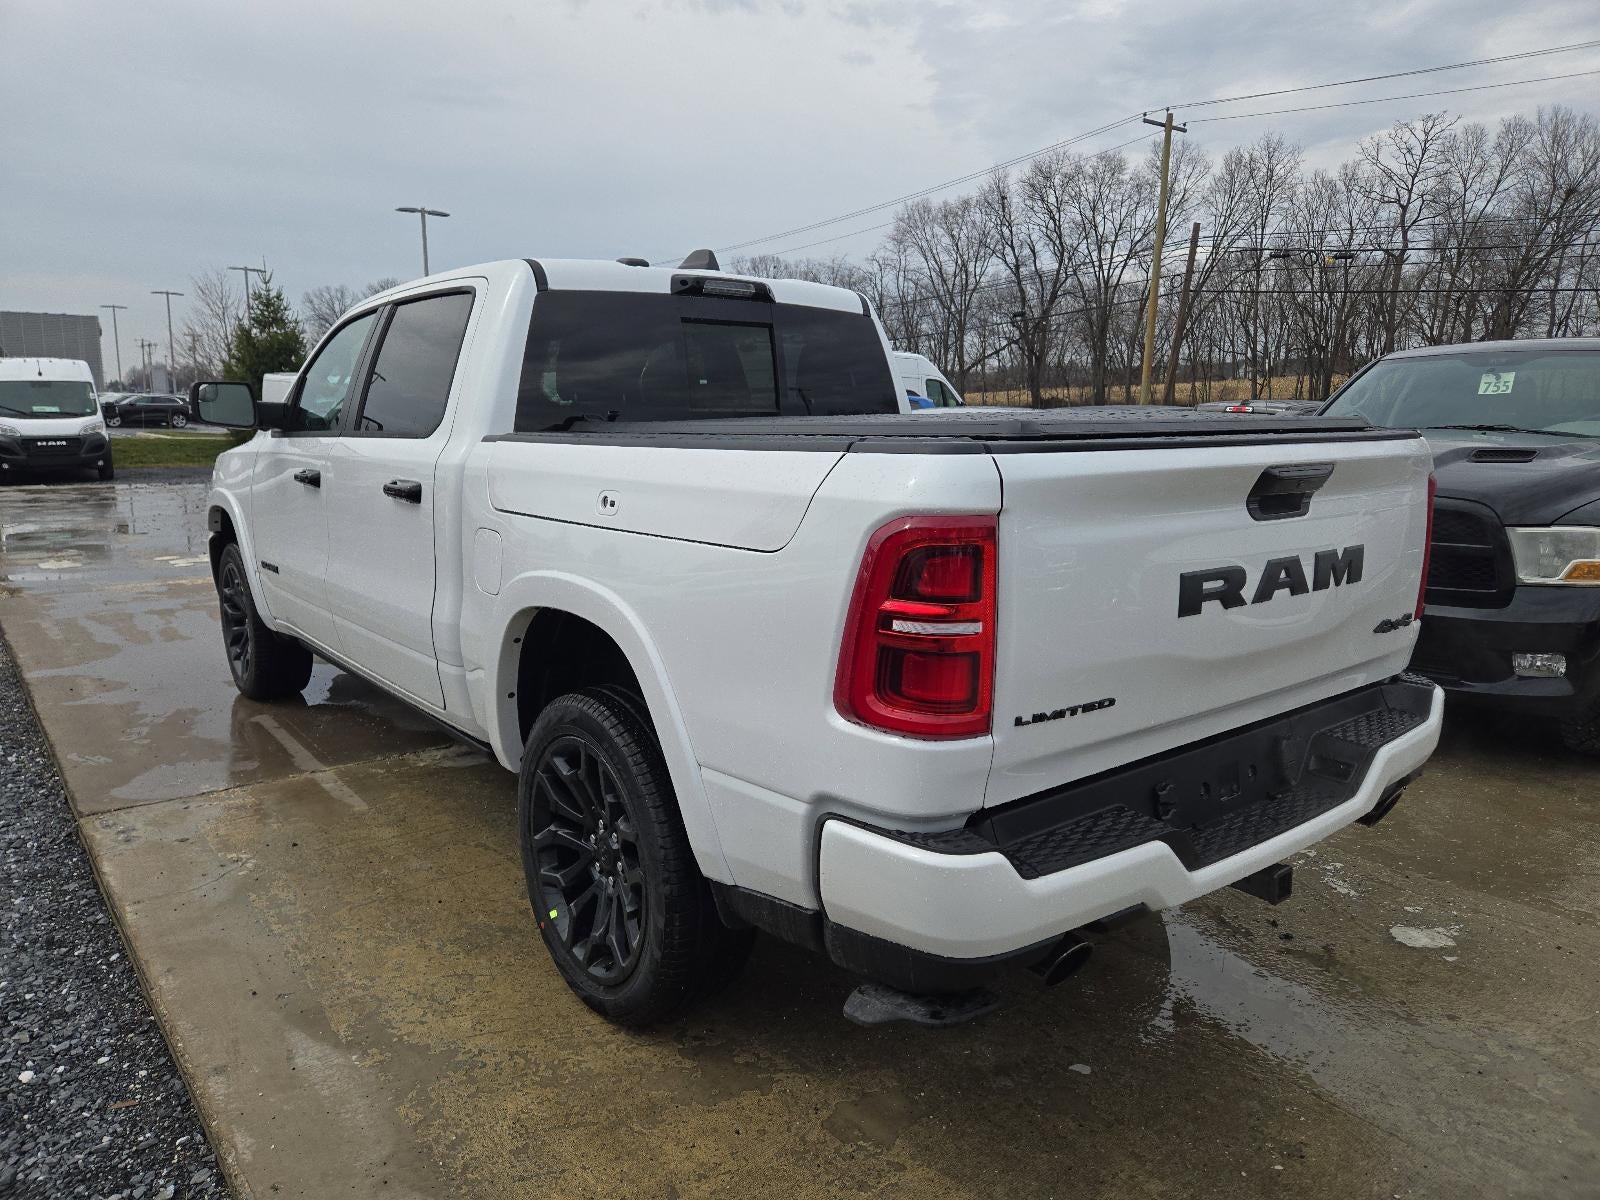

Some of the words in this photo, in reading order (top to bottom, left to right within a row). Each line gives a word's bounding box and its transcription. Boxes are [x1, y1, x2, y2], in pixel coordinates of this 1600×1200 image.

[1483, 380, 1511, 393] 755
[1178, 544, 1365, 618] RAM
[1014, 697, 1116, 727] LIMITED
